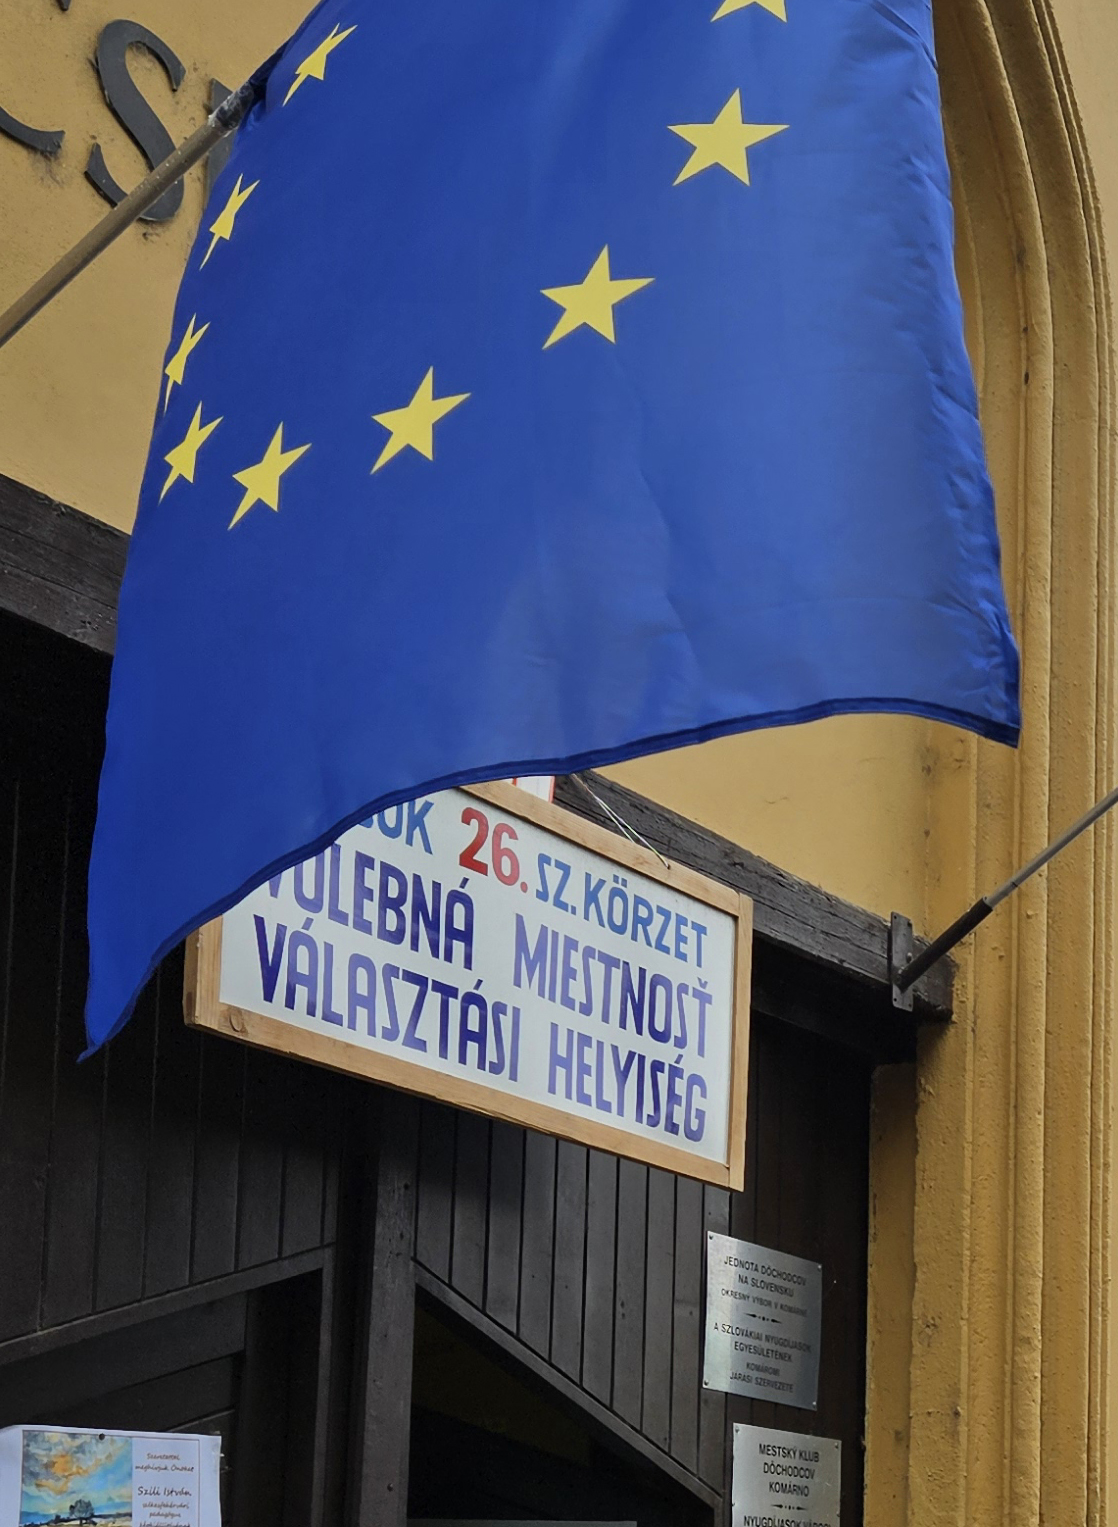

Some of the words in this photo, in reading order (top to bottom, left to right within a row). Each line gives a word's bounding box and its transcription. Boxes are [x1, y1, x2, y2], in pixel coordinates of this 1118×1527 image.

[358, 799, 434, 855] OK
[459, 807, 528, 893] 26.
[513, 913, 713, 1058] MIESTNOSŤ
[253, 914, 521, 1083] VÁLASZTÁSI
[548, 1022, 708, 1142] HELYISÉG
[724, 1256, 759, 1273] JEDNOTA
[738, 1274, 749, 1285] NA
[750, 1277, 794, 1297] SLOVENSKU
[713, 1322, 719, 1331] A
[759, 1443, 797, 1459] MESTSKÝ
[799, 1449, 820, 1463] KLUB
[769, 1481, 809, 1497] KOMÁRNO
